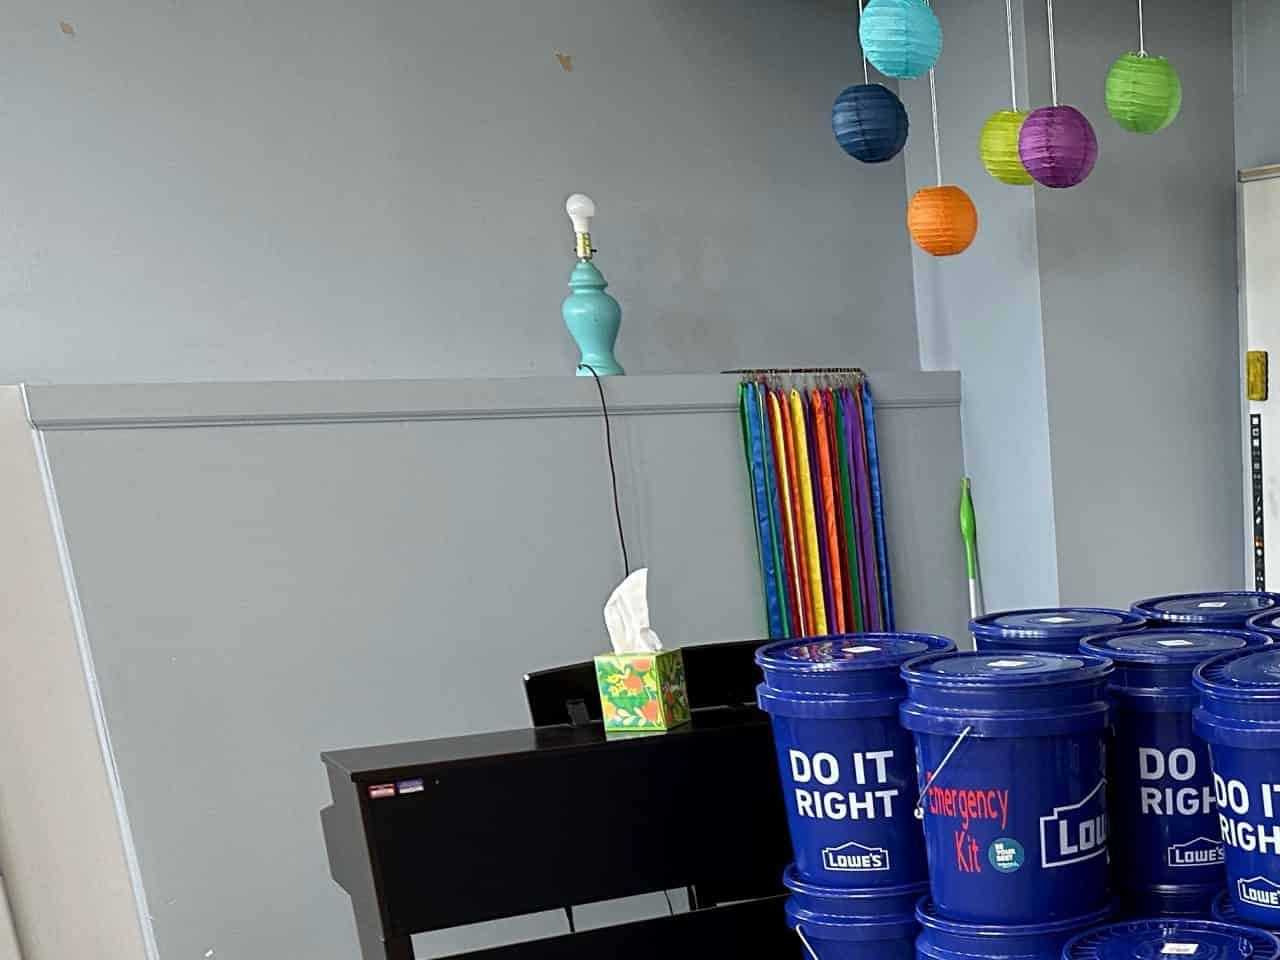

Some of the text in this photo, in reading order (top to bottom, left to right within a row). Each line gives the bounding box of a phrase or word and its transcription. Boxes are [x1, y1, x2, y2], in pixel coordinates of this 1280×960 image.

[789, 748, 895, 786] DO IT
[1139, 748, 1197, 781] DO
[795, 788, 899, 820] RIGHT
[1214, 771, 1250, 816] DO
[828, 852, 884, 868] LOWE'S
[955, 831, 982, 873] Kit
